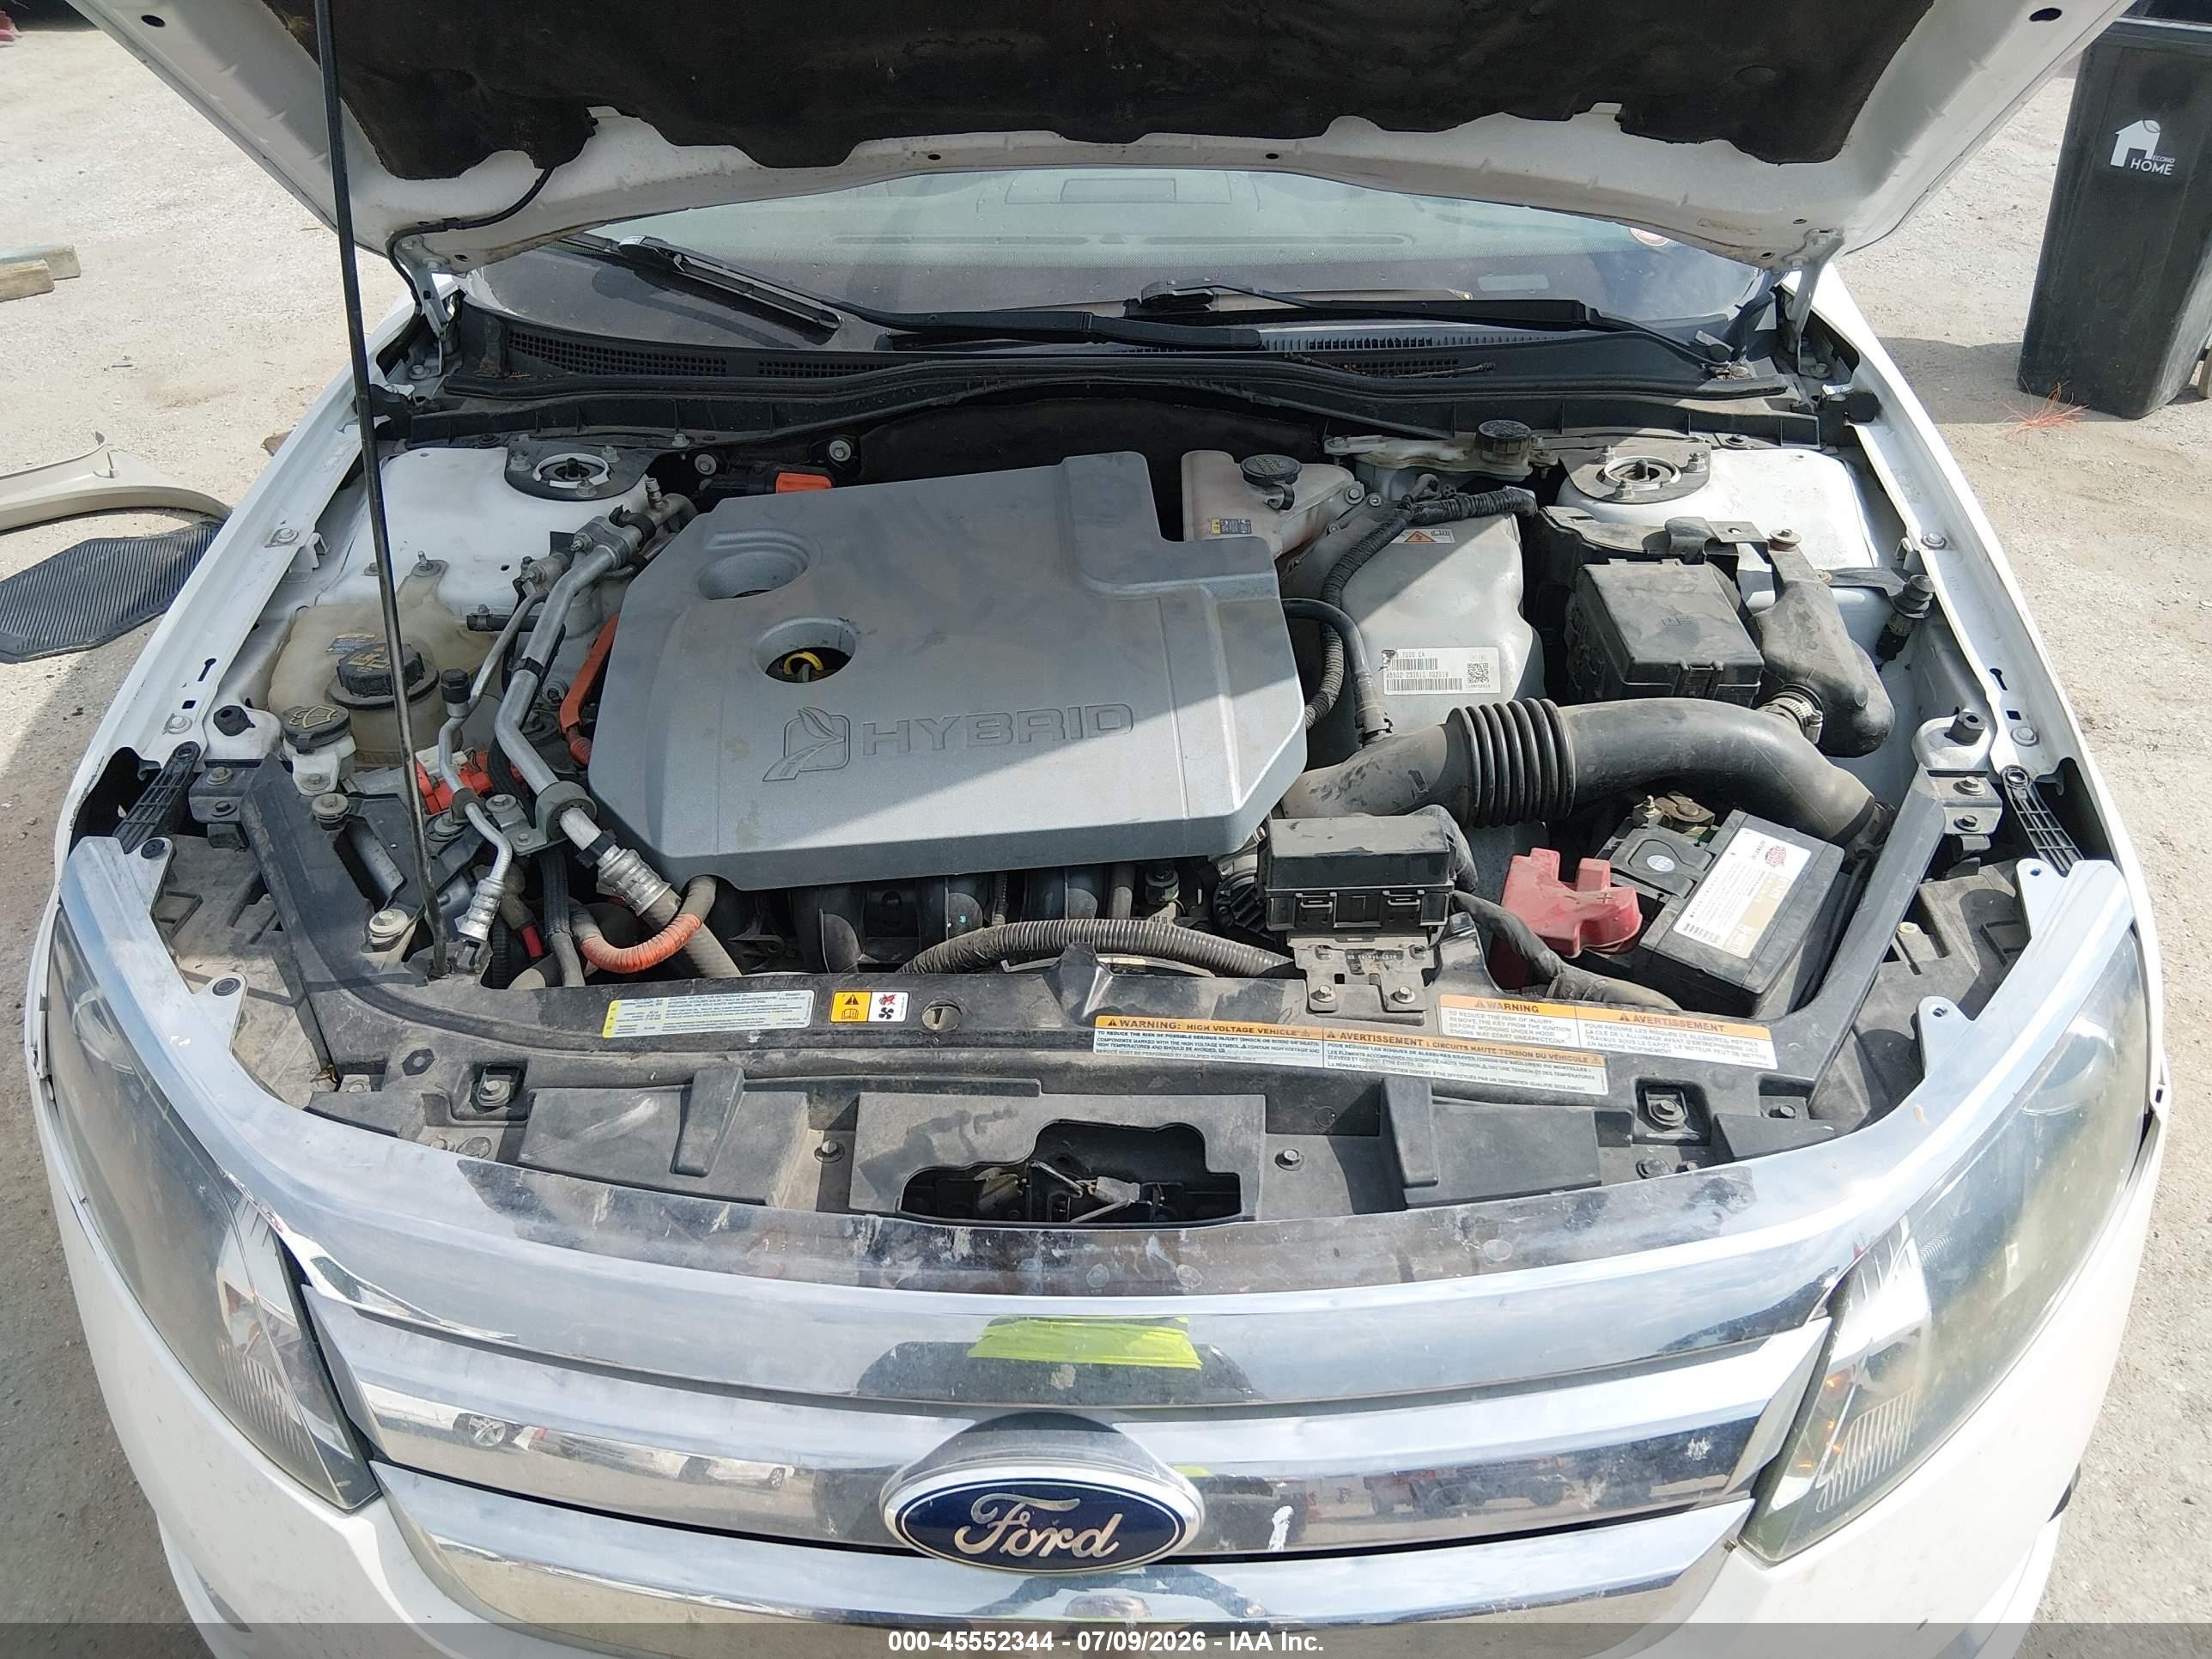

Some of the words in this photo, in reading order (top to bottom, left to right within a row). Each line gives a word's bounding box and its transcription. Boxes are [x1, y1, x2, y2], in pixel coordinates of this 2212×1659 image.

[2130, 157, 2174, 176] HOME
[861, 702, 1134, 757] HYBRID
[1486, 1001, 1539, 1012] WARNING
[1119, 1019, 1181, 1029] WARNING:
[1212, 1024, 1254, 1033] VOLTAGE
[1257, 1026, 1297, 1036] VEHICLE
[1632, 1015, 1725, 1032] AVERTISSEMENT
[1340, 1031, 1422, 1046] AVERTISSEMENT
[1432, 1040, 1468, 1050] CIRCUITS
[1470, 1044, 1495, 1053] HAUTE
[1498, 1047, 1533, 1057] TENSION
[954, 1492, 1123, 1558] Ford
